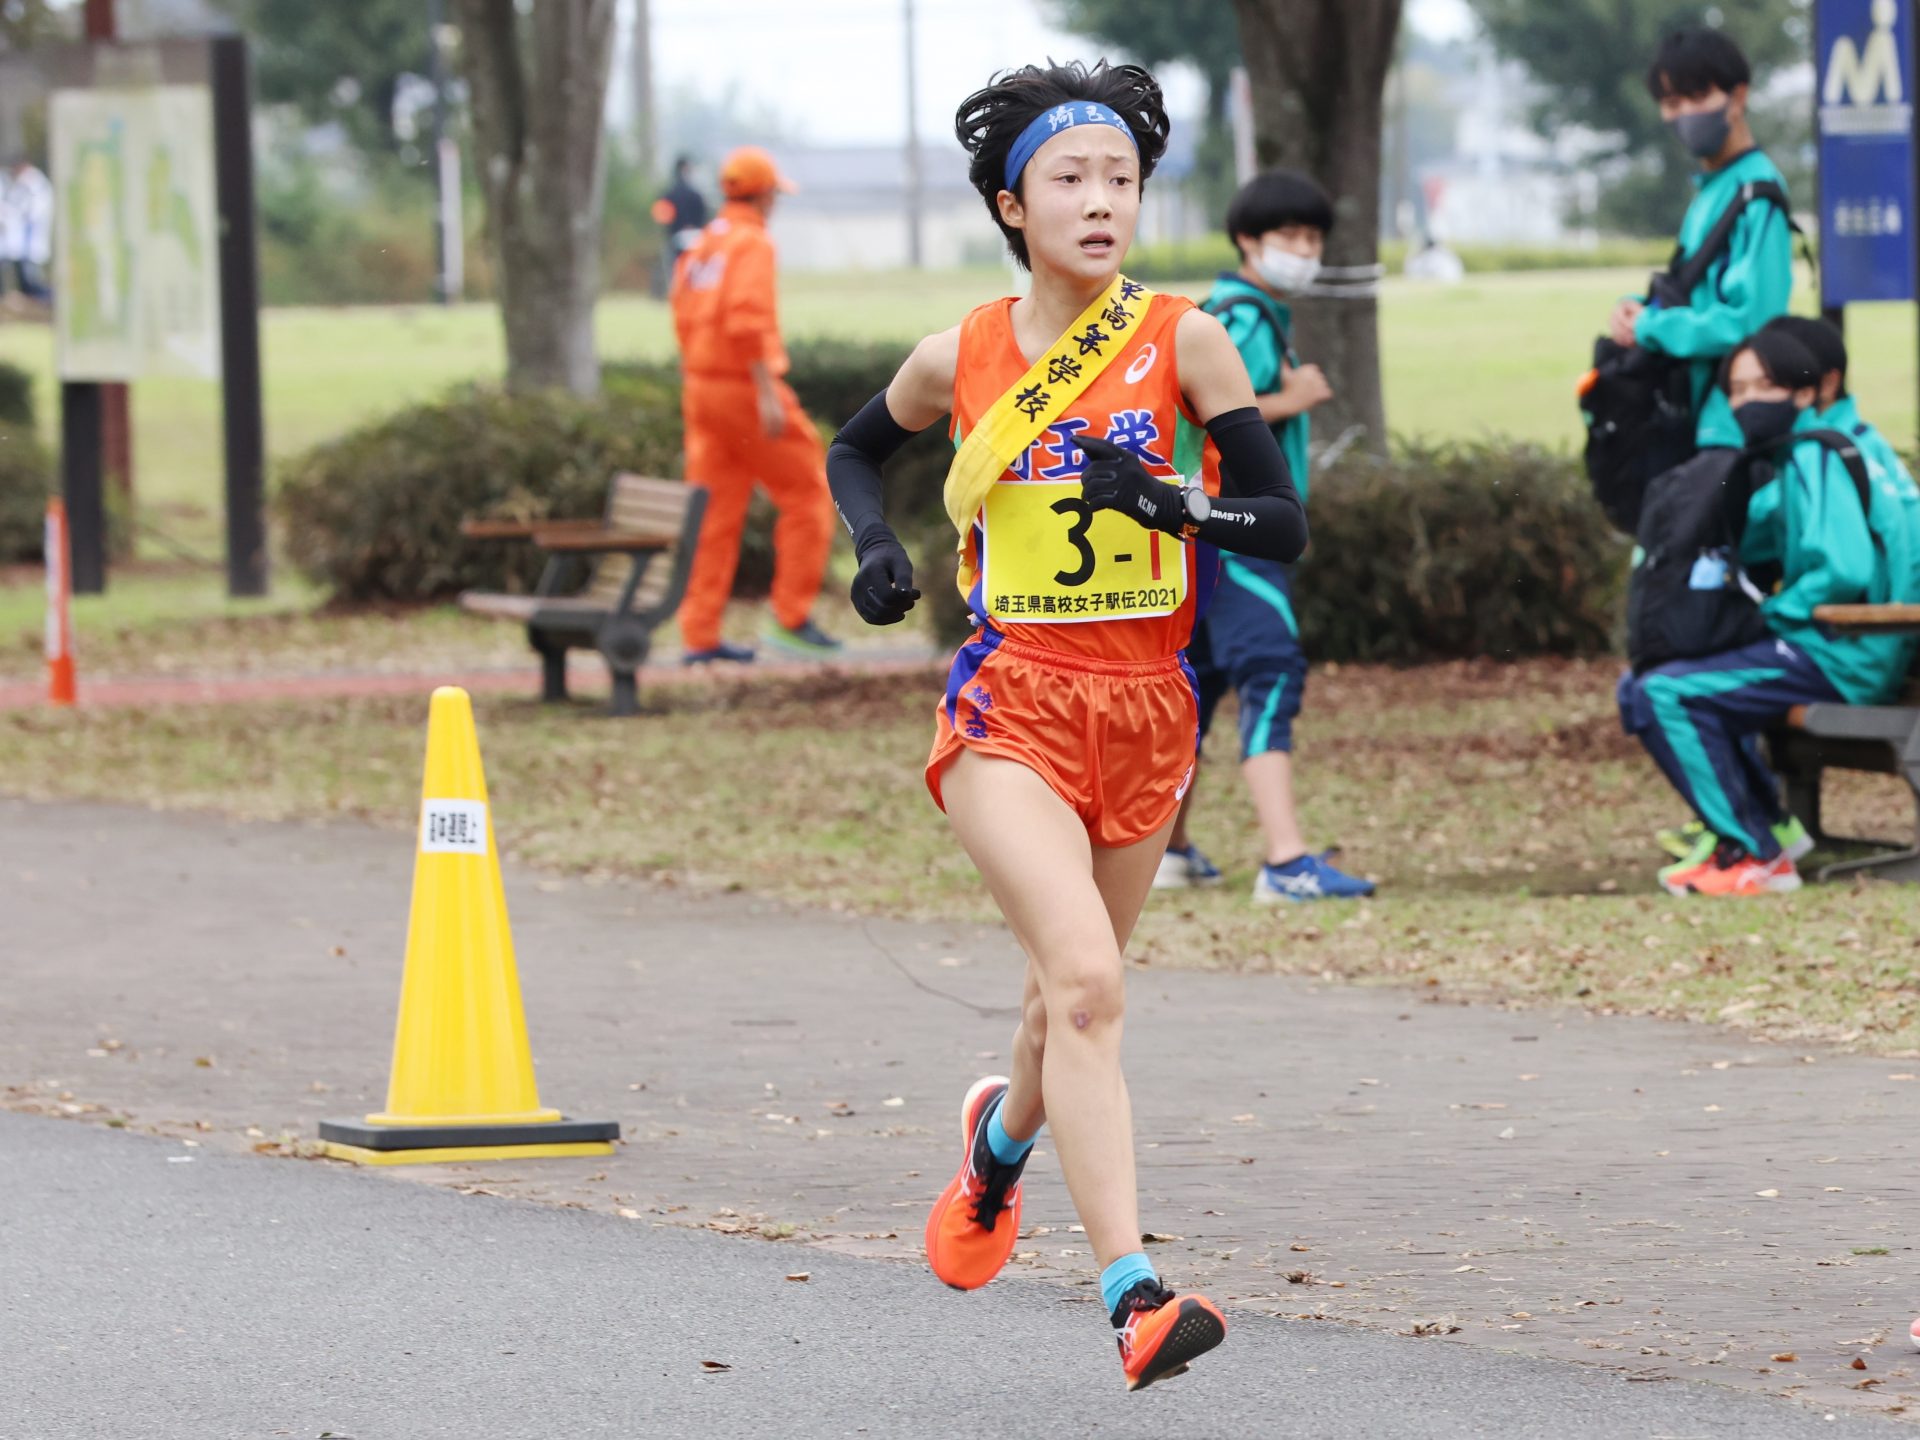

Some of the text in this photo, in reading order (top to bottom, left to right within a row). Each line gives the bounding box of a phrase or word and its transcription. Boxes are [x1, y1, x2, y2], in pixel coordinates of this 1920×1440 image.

[1009, 409, 1169, 481] 玉栄
[995, 588, 1177, 613] 埼玉県高校女子駅伝2021
